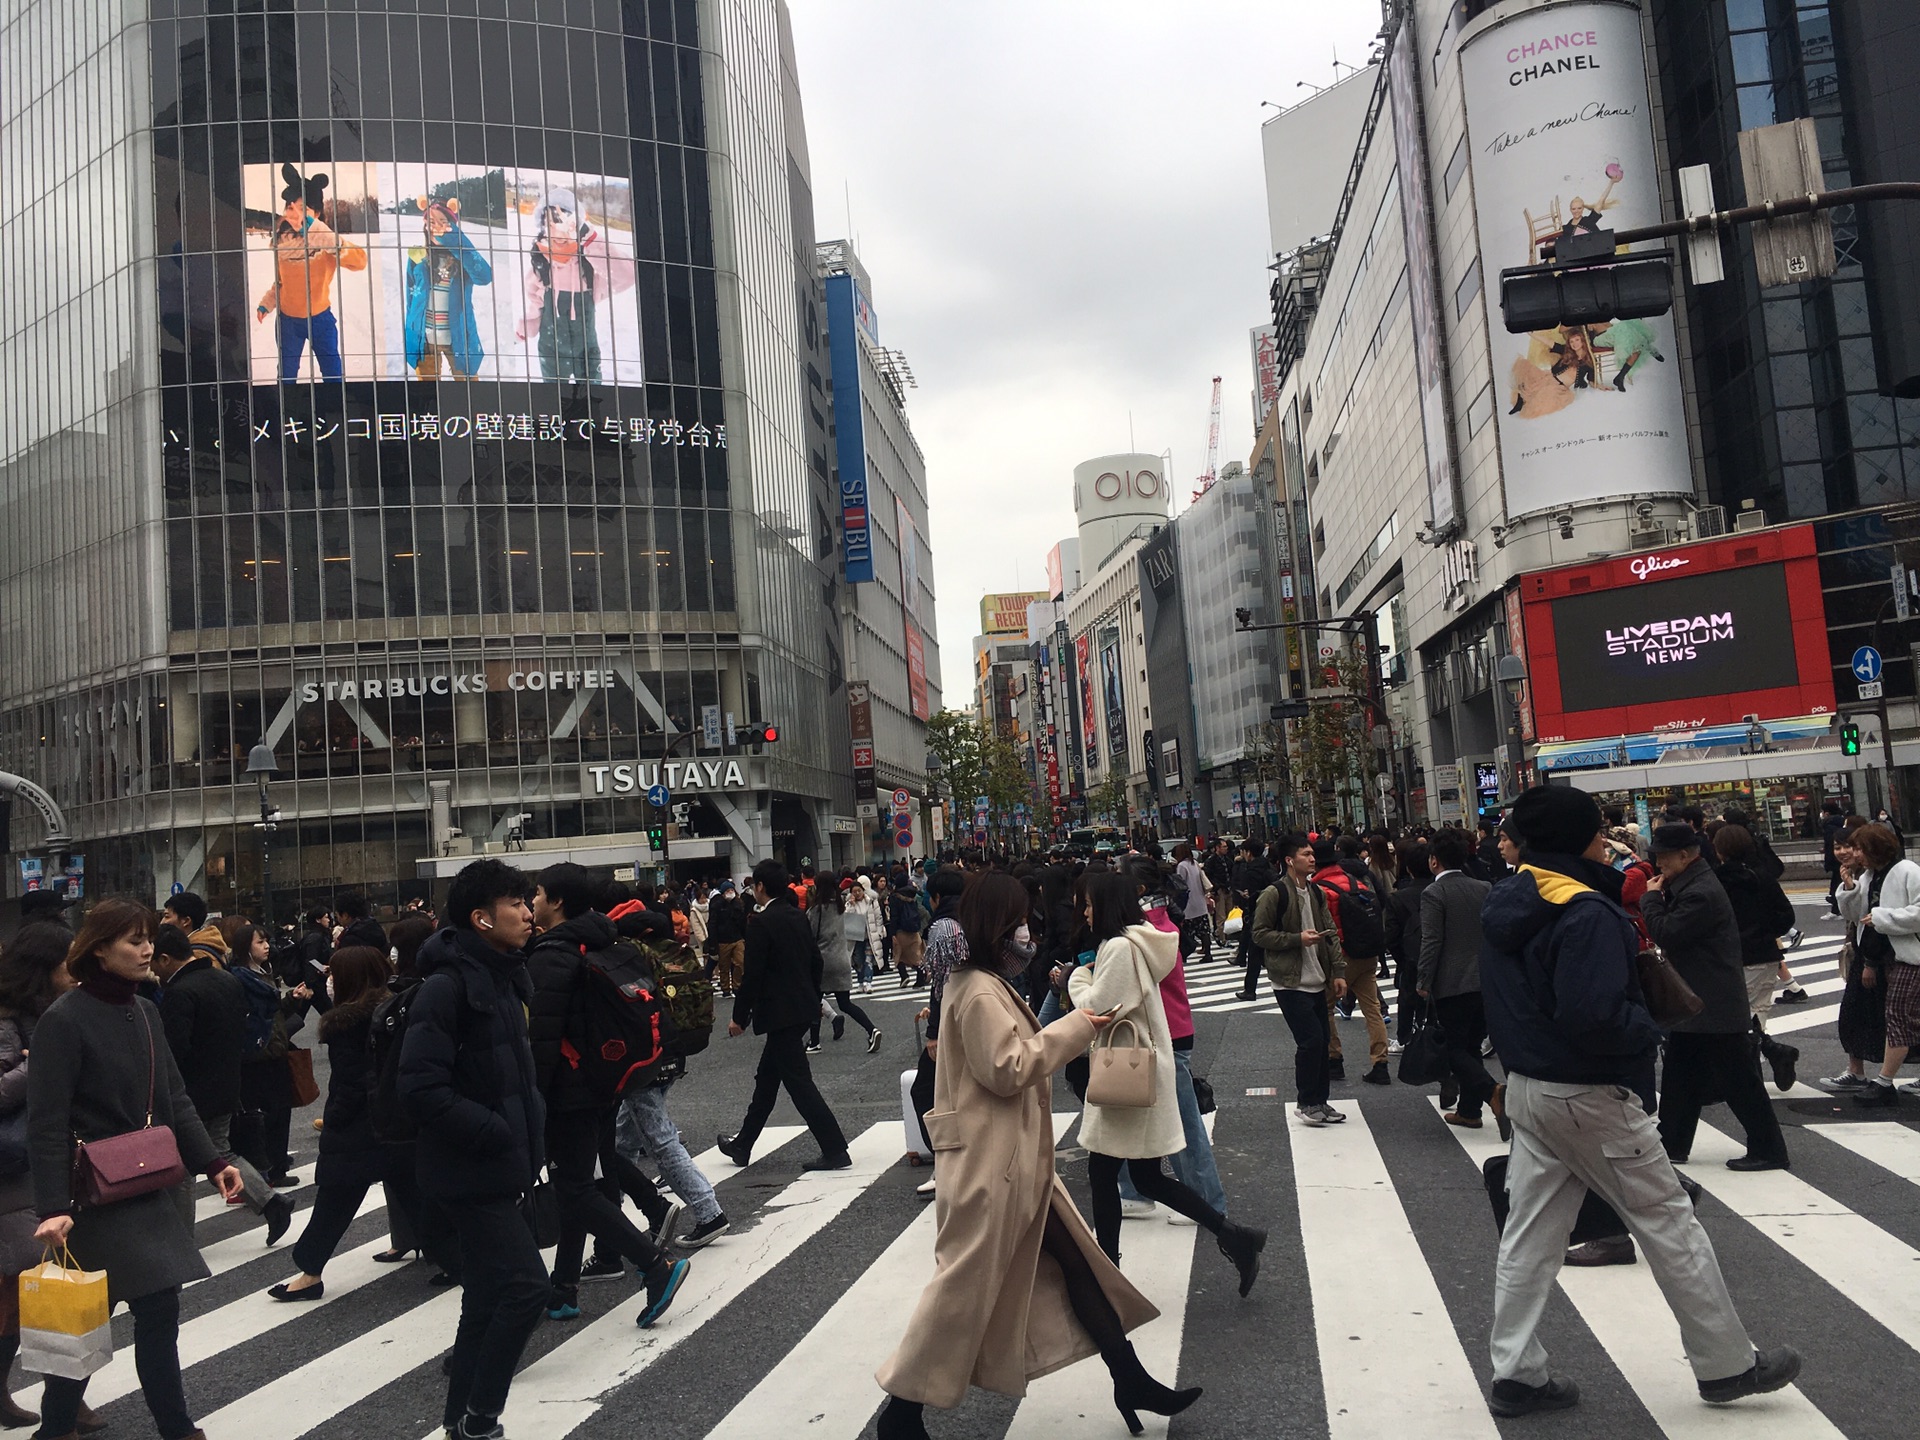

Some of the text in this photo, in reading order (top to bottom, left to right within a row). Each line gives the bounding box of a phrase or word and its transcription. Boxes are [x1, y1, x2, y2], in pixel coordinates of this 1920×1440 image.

[1507, 31, 1598, 63] CHANCE
[1509, 55, 1600, 86] CHANEL
[1485, 131, 1525, 155] Take
[1526, 128, 1538, 138] a
[1541, 113, 1578, 133] new
[1630, 556, 1689, 580] Glico
[1607, 626, 1735, 656] STADIUM
[1646, 646, 1697, 665] NEWS
[302, 669, 615, 702] STARBUCKS COFFEE
[856, 750, 870, 764] 本
[1557, 751, 1615, 767] SANZENR
[588, 760, 745, 793] TSUTAYA
